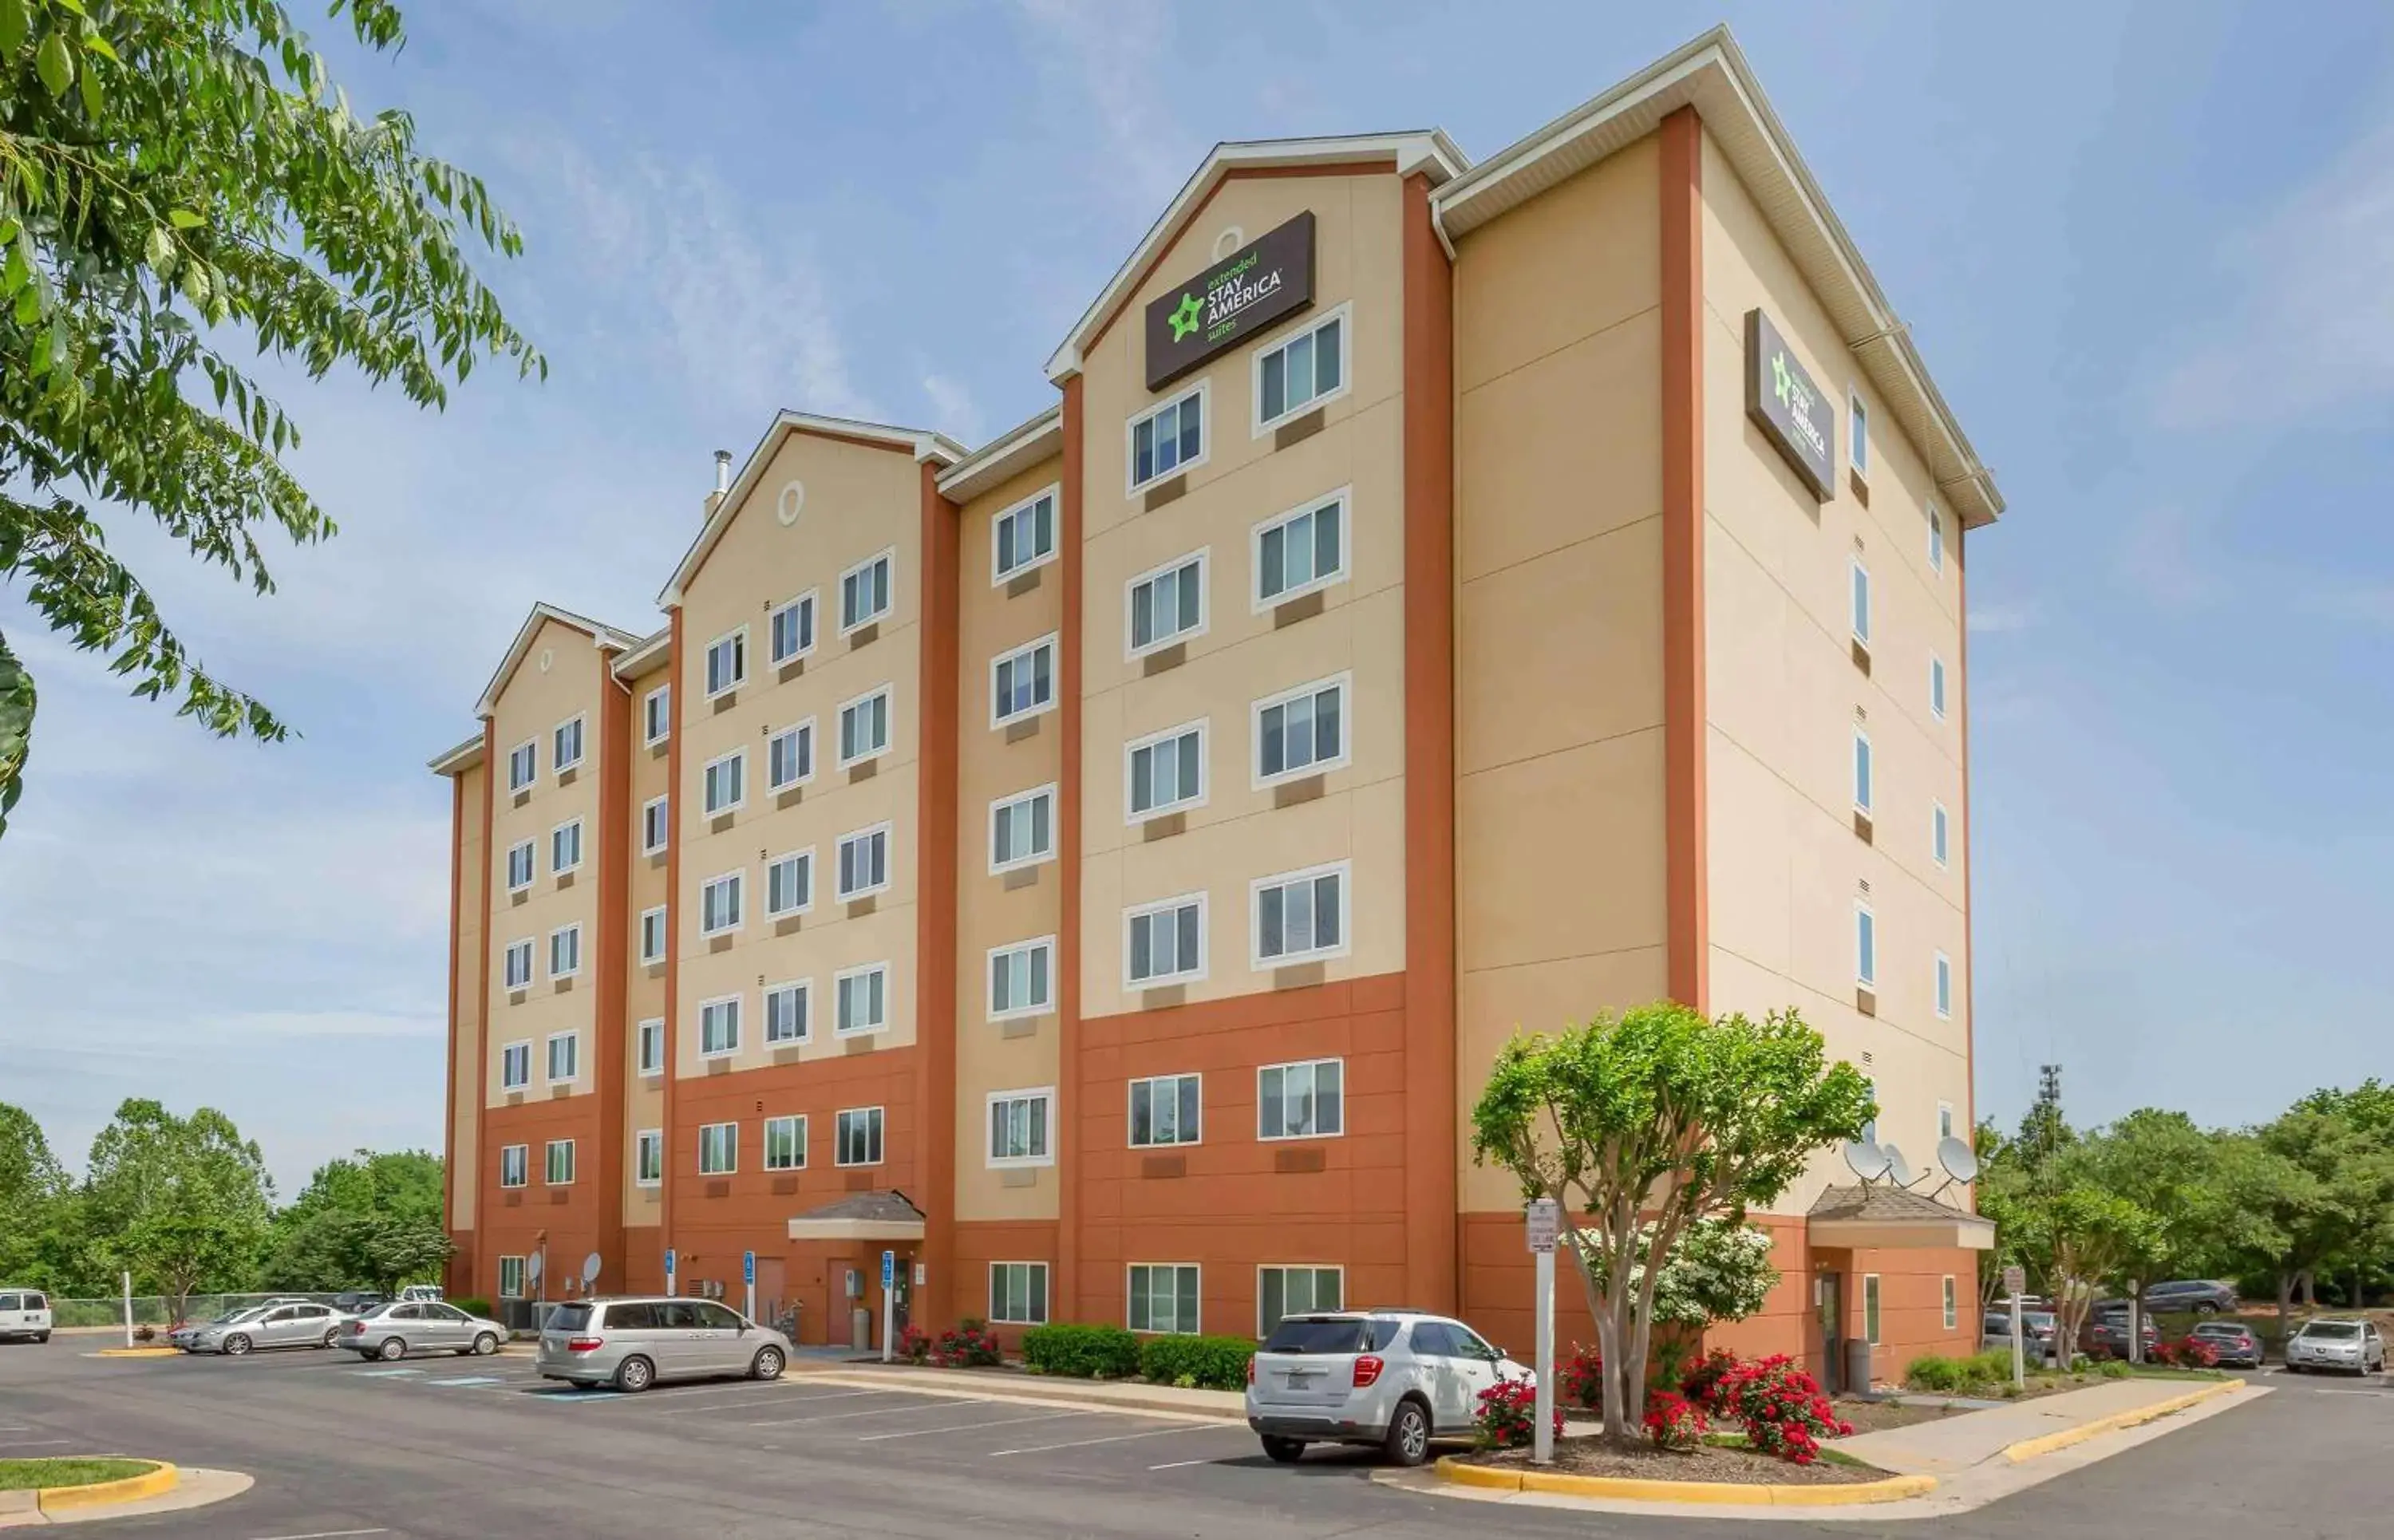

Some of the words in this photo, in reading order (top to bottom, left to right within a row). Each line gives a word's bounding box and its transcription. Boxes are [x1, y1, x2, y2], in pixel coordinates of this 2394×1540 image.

[1208, 251, 1257, 290] extended
[1207, 270, 1281, 325] AMERICA
[1208, 274, 1244, 308] STAY
[1207, 319, 1237, 342] suites
